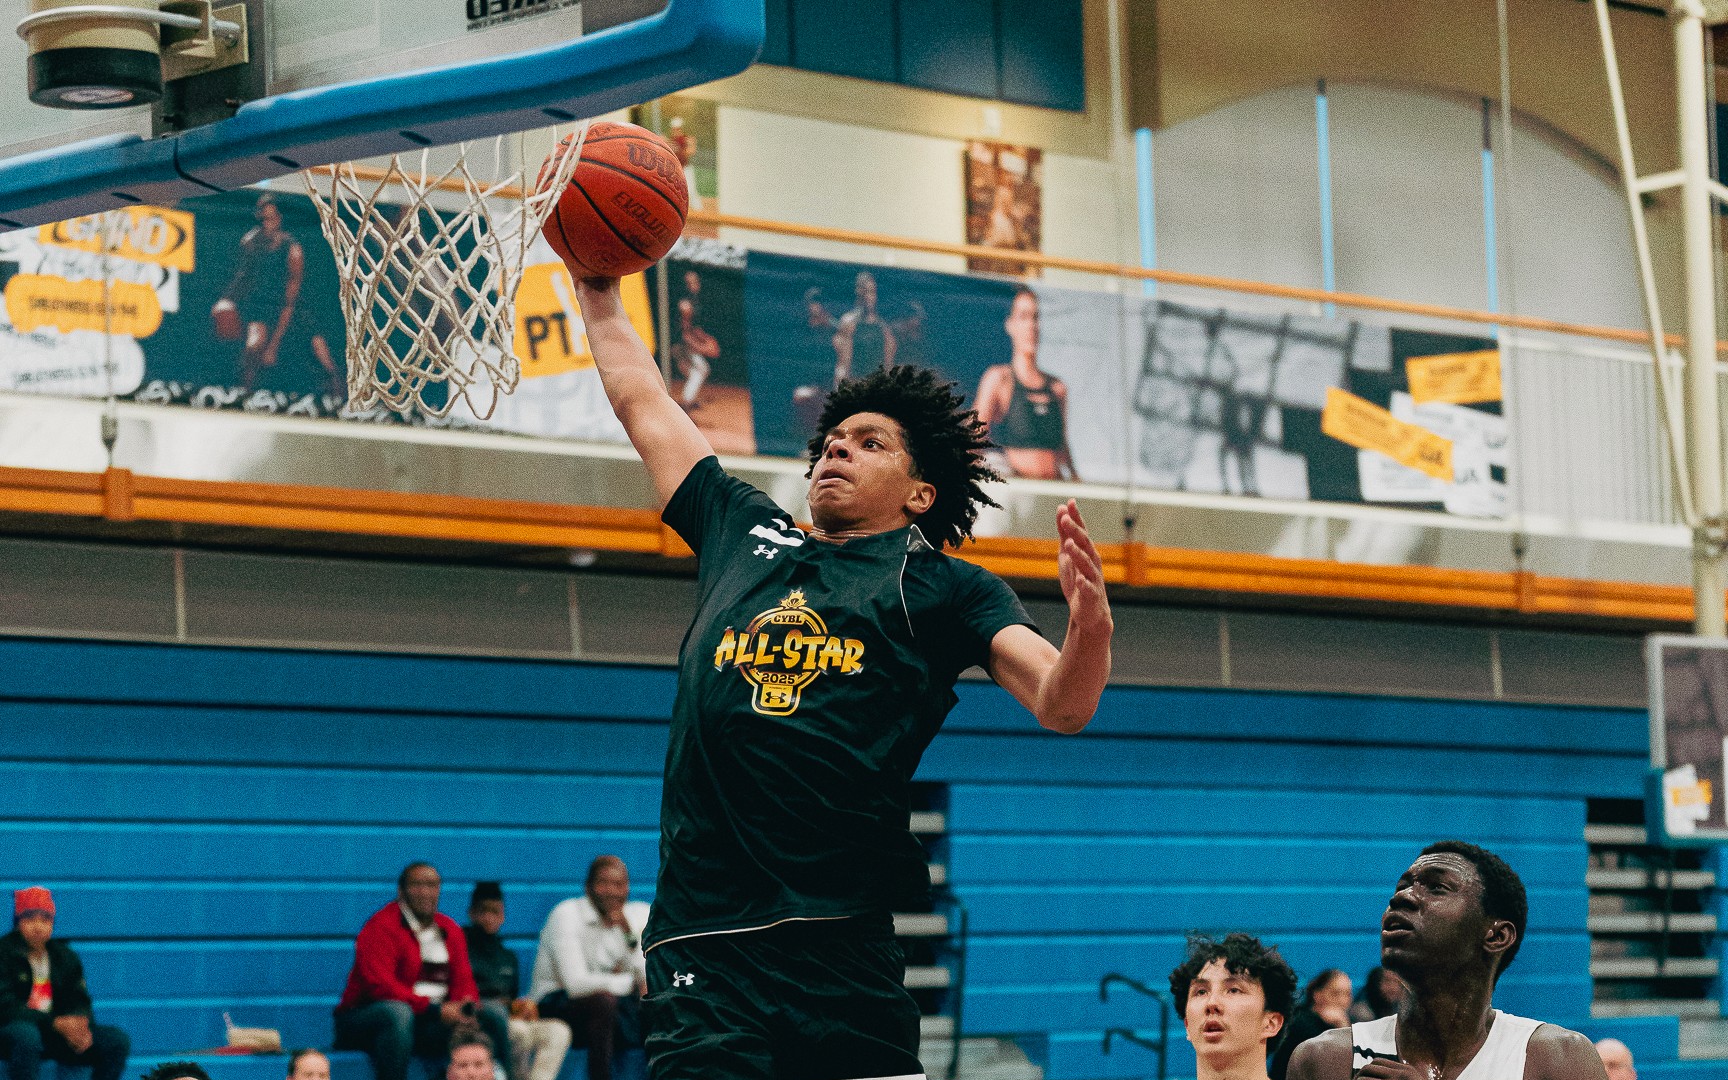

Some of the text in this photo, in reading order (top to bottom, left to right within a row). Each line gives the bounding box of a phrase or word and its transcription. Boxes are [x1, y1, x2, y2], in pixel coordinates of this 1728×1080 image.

[773, 614, 803, 624] CYBL
[713, 628, 866, 674] ALL-STAR
[761, 673, 795, 685] 2025
